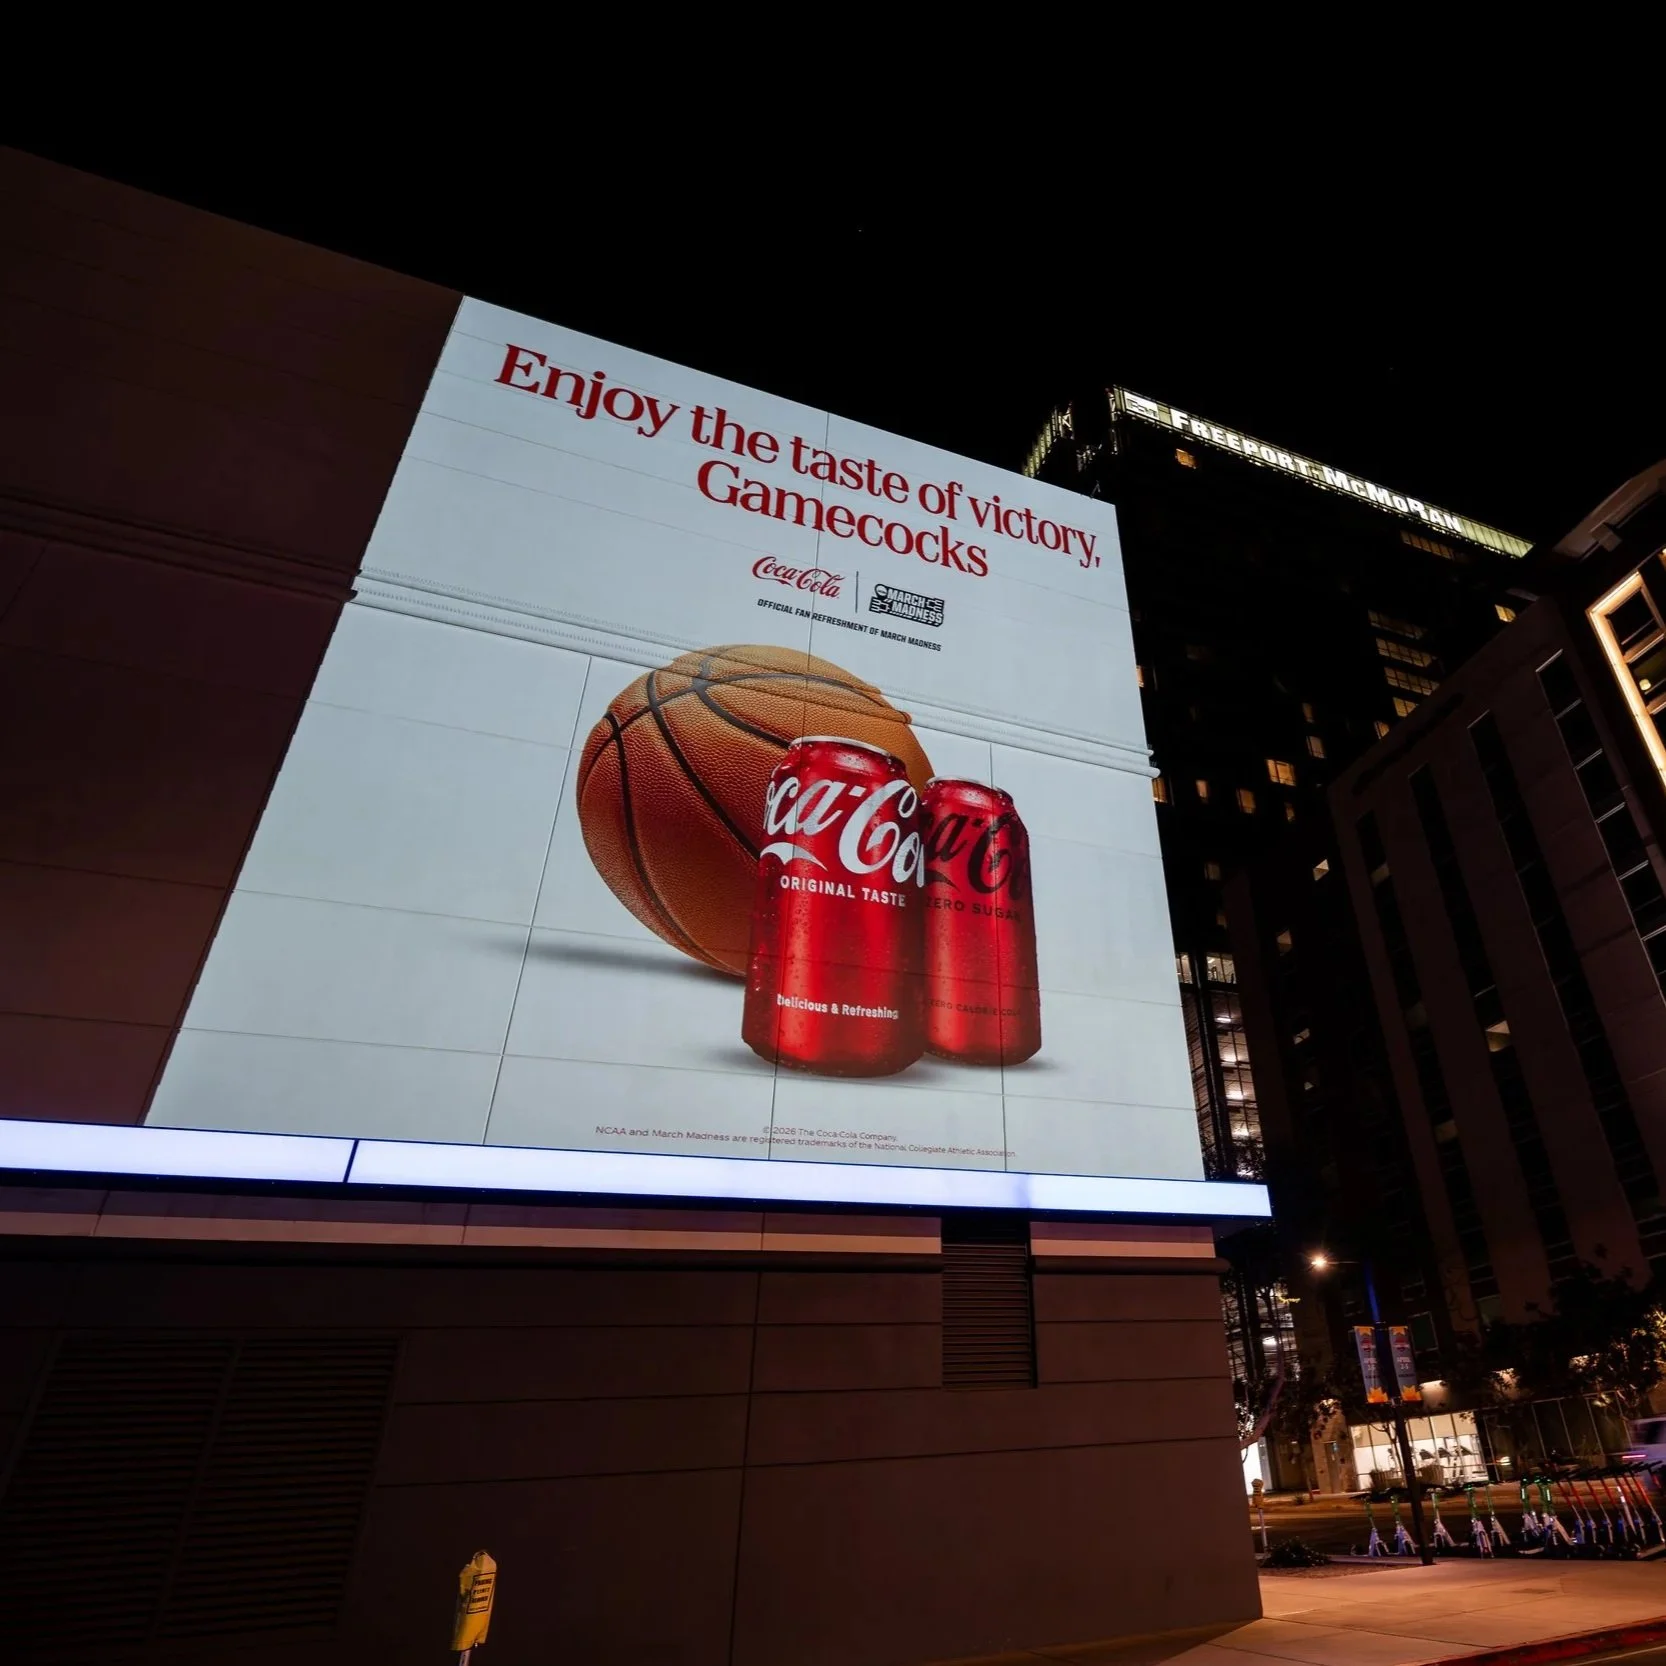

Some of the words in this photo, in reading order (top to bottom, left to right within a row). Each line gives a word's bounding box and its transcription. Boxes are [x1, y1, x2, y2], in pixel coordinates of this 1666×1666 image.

[495, 344, 680, 438] Enjoy
[691, 405, 780, 463] the
[790, 436, 910, 504] taste
[919, 482, 964, 520] of
[970, 495, 1101, 568] victory,
[697, 460, 989, 577] Gamecocks
[752, 556, 845, 598] Coca-Cola
[887, 588, 927, 608] MARCH
[891, 601, 943, 624] MADNESS
[757, 598, 793, 614] OFFICIAL
[794, 608, 811, 618] FAN
[811, 612, 868, 632] REFRESHMENT
[869, 627, 879, 635] OF
[880, 630, 907, 642] MARCH
[908, 637, 942, 652] MADNESS
[780, 875, 856, 899] ORIGINAL
[861, 887, 907, 907] TASTE
[926, 896, 964, 912] ZERO
[777, 994, 828, 1013] Delicious
[830, 1003, 839, 1014] &
[842, 1004, 899, 1020] Refreshing
[595, 1126, 627, 1135] NCAA
[628, 1128, 649, 1136] and
[652, 1129, 683, 1139] March
[686, 1131, 730, 1141] Madness
[732, 1135, 748, 1143] are
[749, 1136, 796, 1145] registered
[798, 1138, 846, 1148] trademarks
[858, 1141, 872, 1149] the
[874, 1142, 906, 1151] National
[908, 1144, 946, 1154] Collegiate
[947, 1147, 975, 1155] Athletic
[773, 1127, 797, 1135] 2026
[798, 1128, 815, 1136] The
[816, 1129, 858, 1139] Coca-Cola
